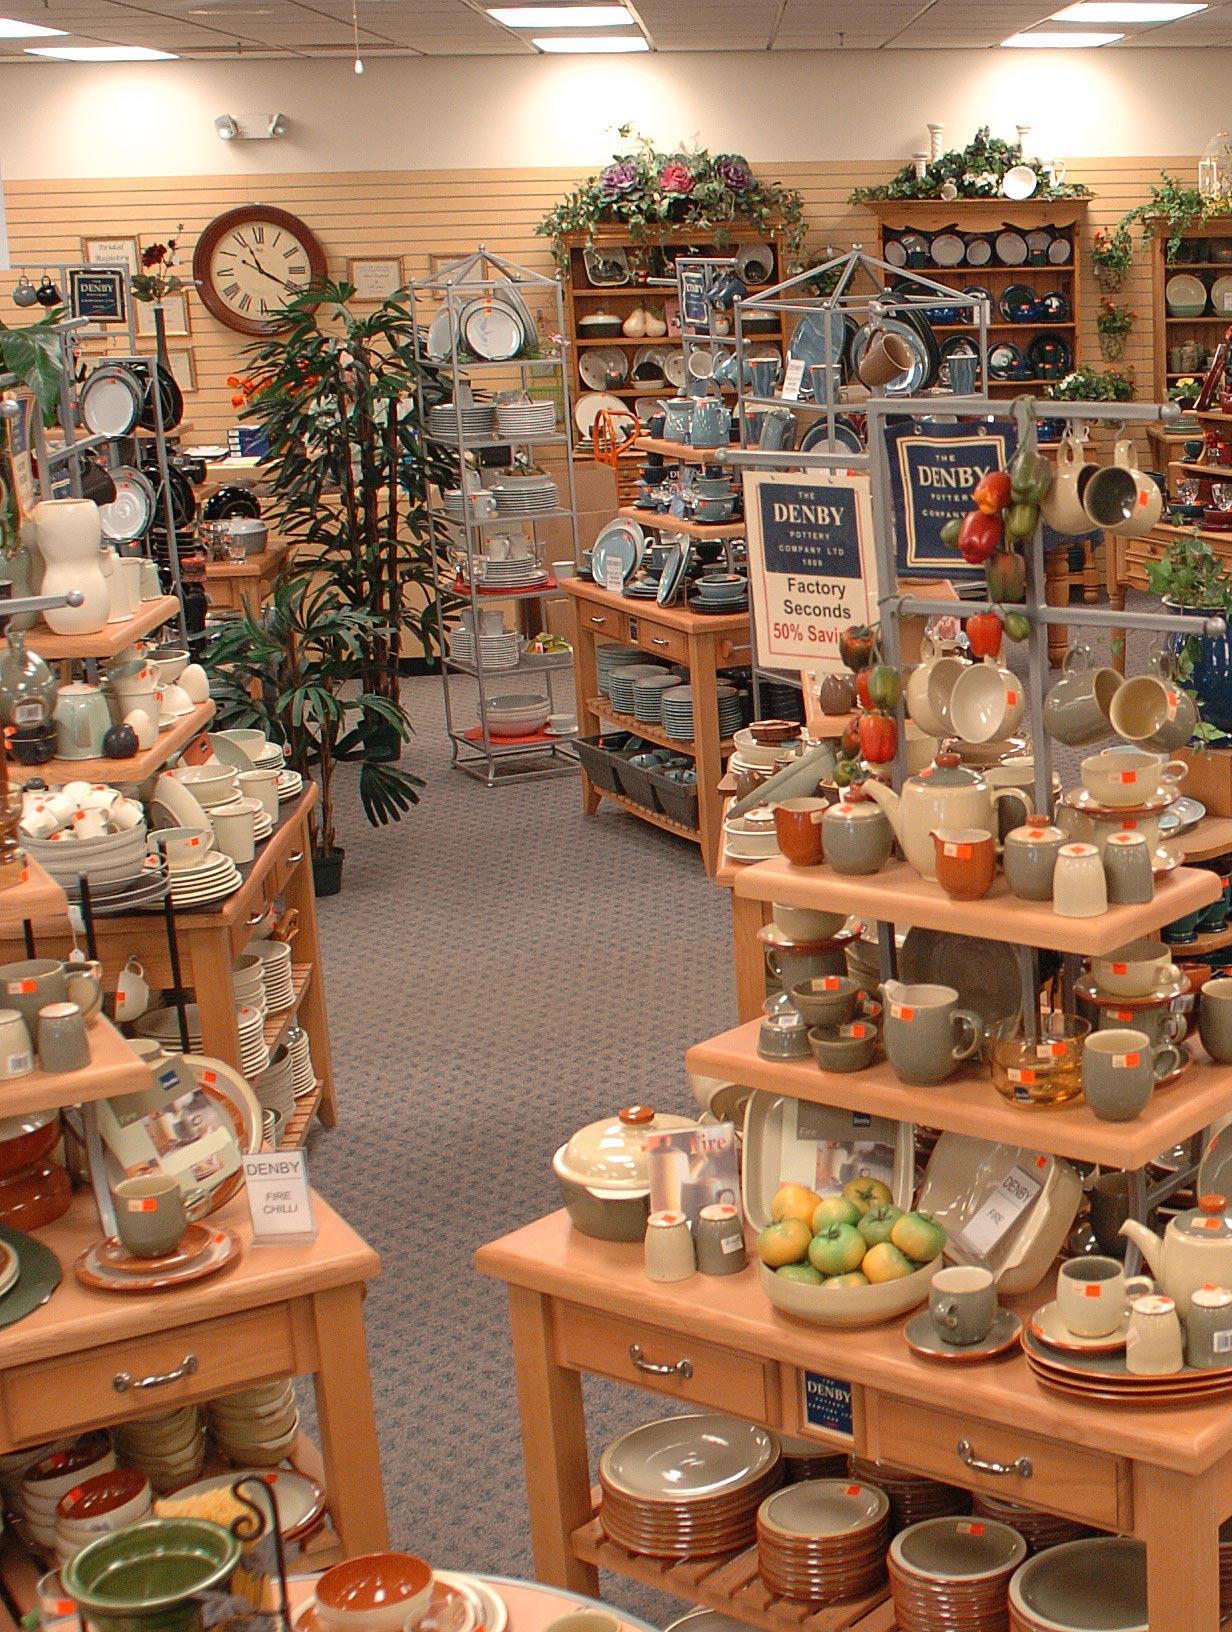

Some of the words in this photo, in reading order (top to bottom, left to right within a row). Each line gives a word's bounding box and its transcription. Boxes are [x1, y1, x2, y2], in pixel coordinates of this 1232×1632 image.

[80, 283, 114, 293] DENBY
[917, 465, 990, 488] DENBY
[799, 491, 815, 500] THE
[773, 503, 844, 526] DENBY
[789, 531, 830, 540] POTTERY
[779, 545, 821, 555] COMPANY
[827, 547, 844, 556] LTD
[787, 577, 845, 600] Factory
[784, 600, 852, 619] Seconds
[773, 622, 803, 641] 50%
[808, 625, 842, 644] Savi
[247, 1162, 300, 1176] DENBY
[266, 1191, 291, 1201] FIRE
[1002, 1176, 1029, 1203] DENBY
[263, 1204, 298, 1214] CHILLI
[807, 1380, 851, 1403] DENBY
